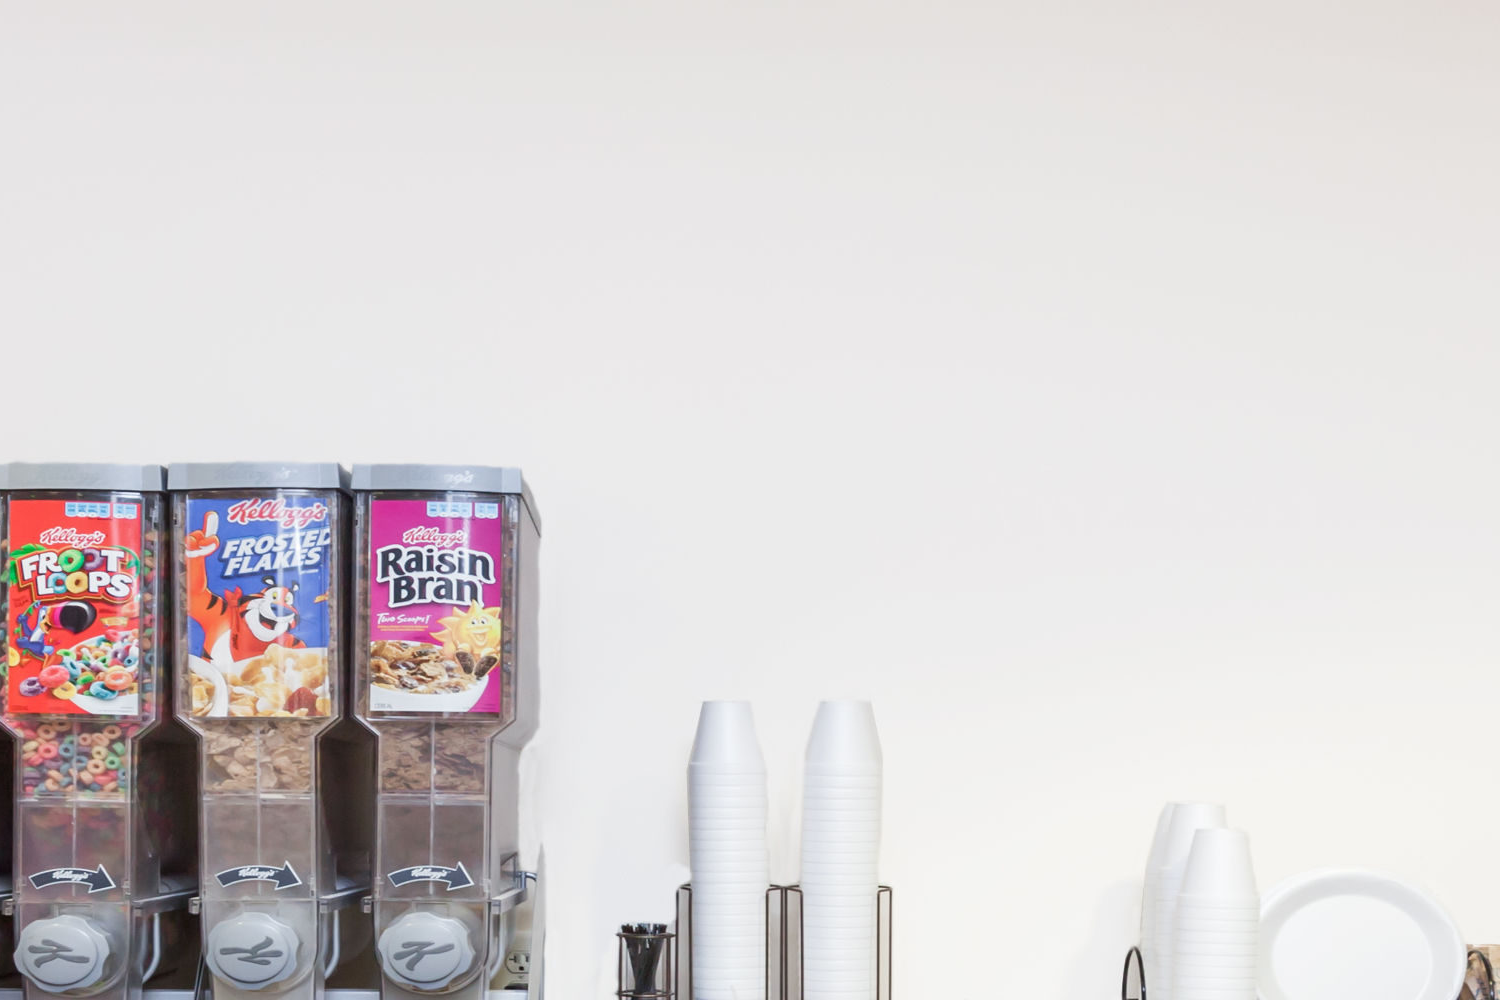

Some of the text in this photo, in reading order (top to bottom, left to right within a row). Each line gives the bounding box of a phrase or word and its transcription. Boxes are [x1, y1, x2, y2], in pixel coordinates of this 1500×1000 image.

[229, 499, 327, 528] Kellogg's
[41, 527, 104, 547] Kellogg's
[222, 528, 331, 559] FROSTED
[404, 526, 466, 547] Kellogg's
[21, 548, 125, 581] FROOT
[225, 547, 322, 576] FLAKES
[379, 548, 491, 581] Raisin
[36, 571, 133, 598] LOOPS
[392, 576, 480, 604] Bran
